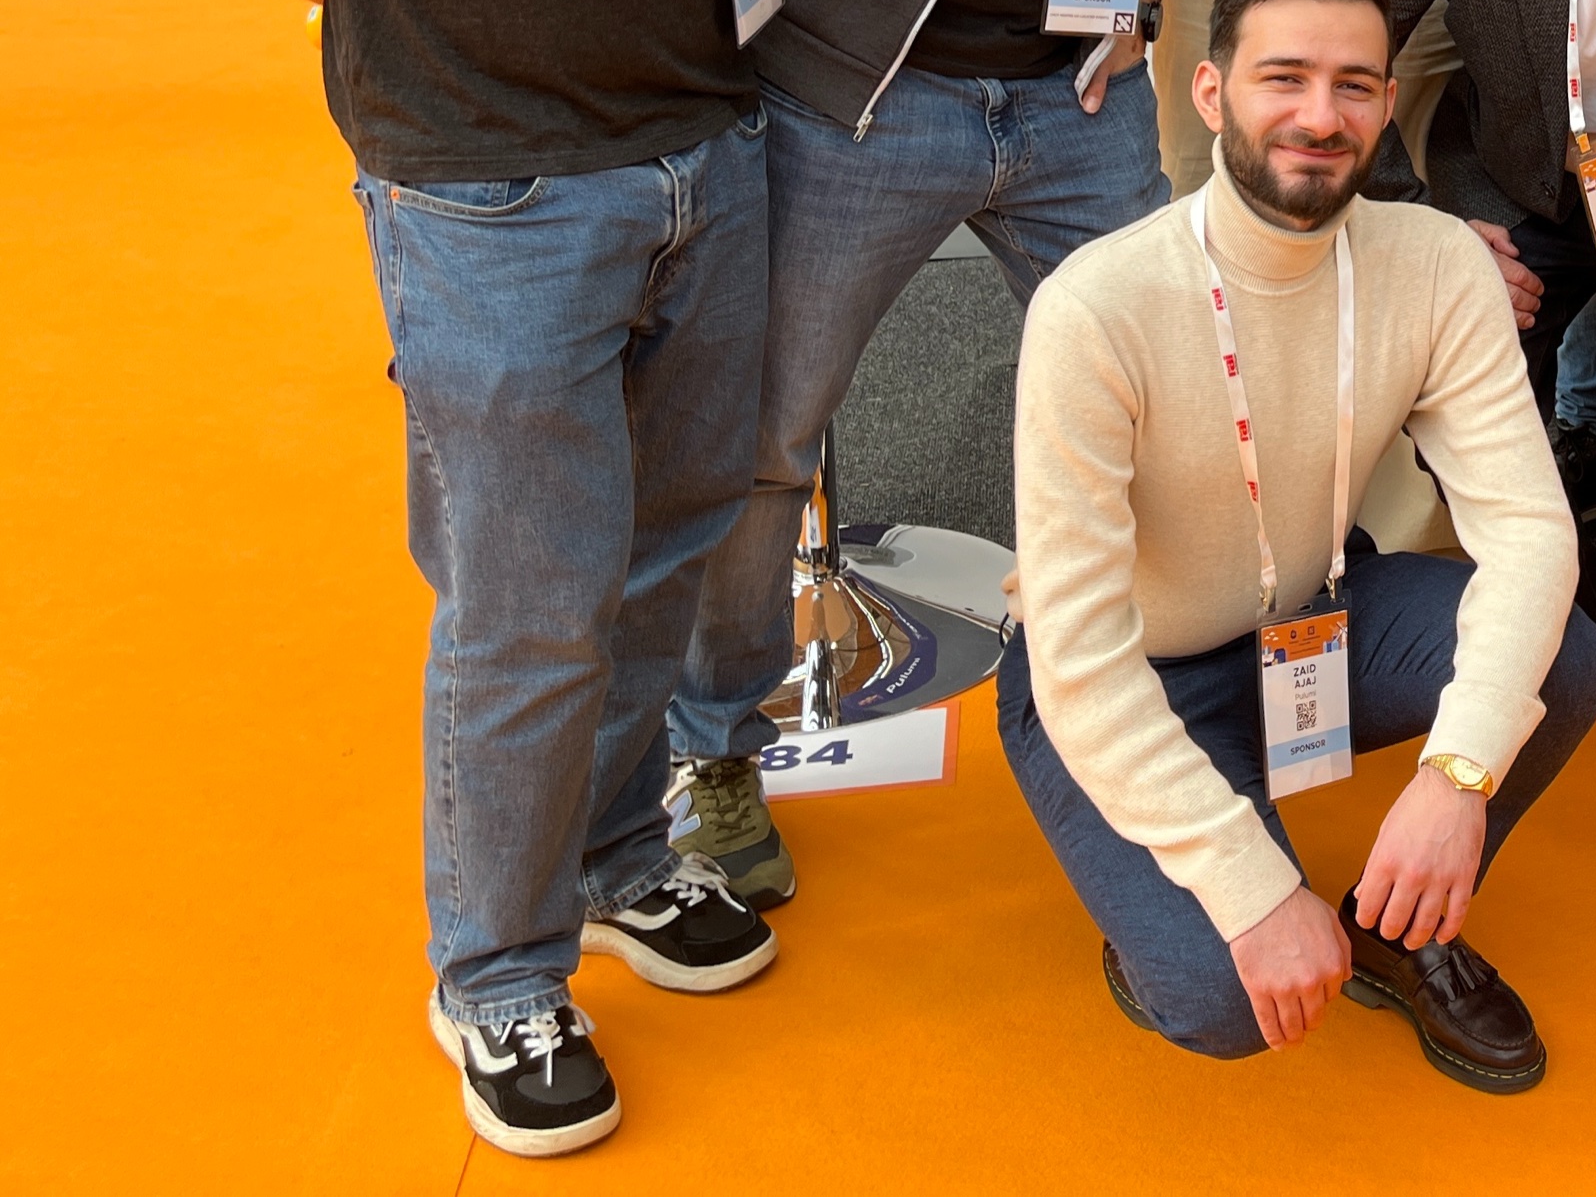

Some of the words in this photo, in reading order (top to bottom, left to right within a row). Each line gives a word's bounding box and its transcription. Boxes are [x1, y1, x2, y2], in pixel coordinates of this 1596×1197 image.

[886, 657, 920, 694] Pulumi
[1293, 664, 1316, 678] ZAID
[1294, 676, 1316, 689] AJAJ
[1295, 690, 1317, 701] Pulumi
[760, 739, 853, 771] 84
[1290, 739, 1326, 756] SPONSOR
